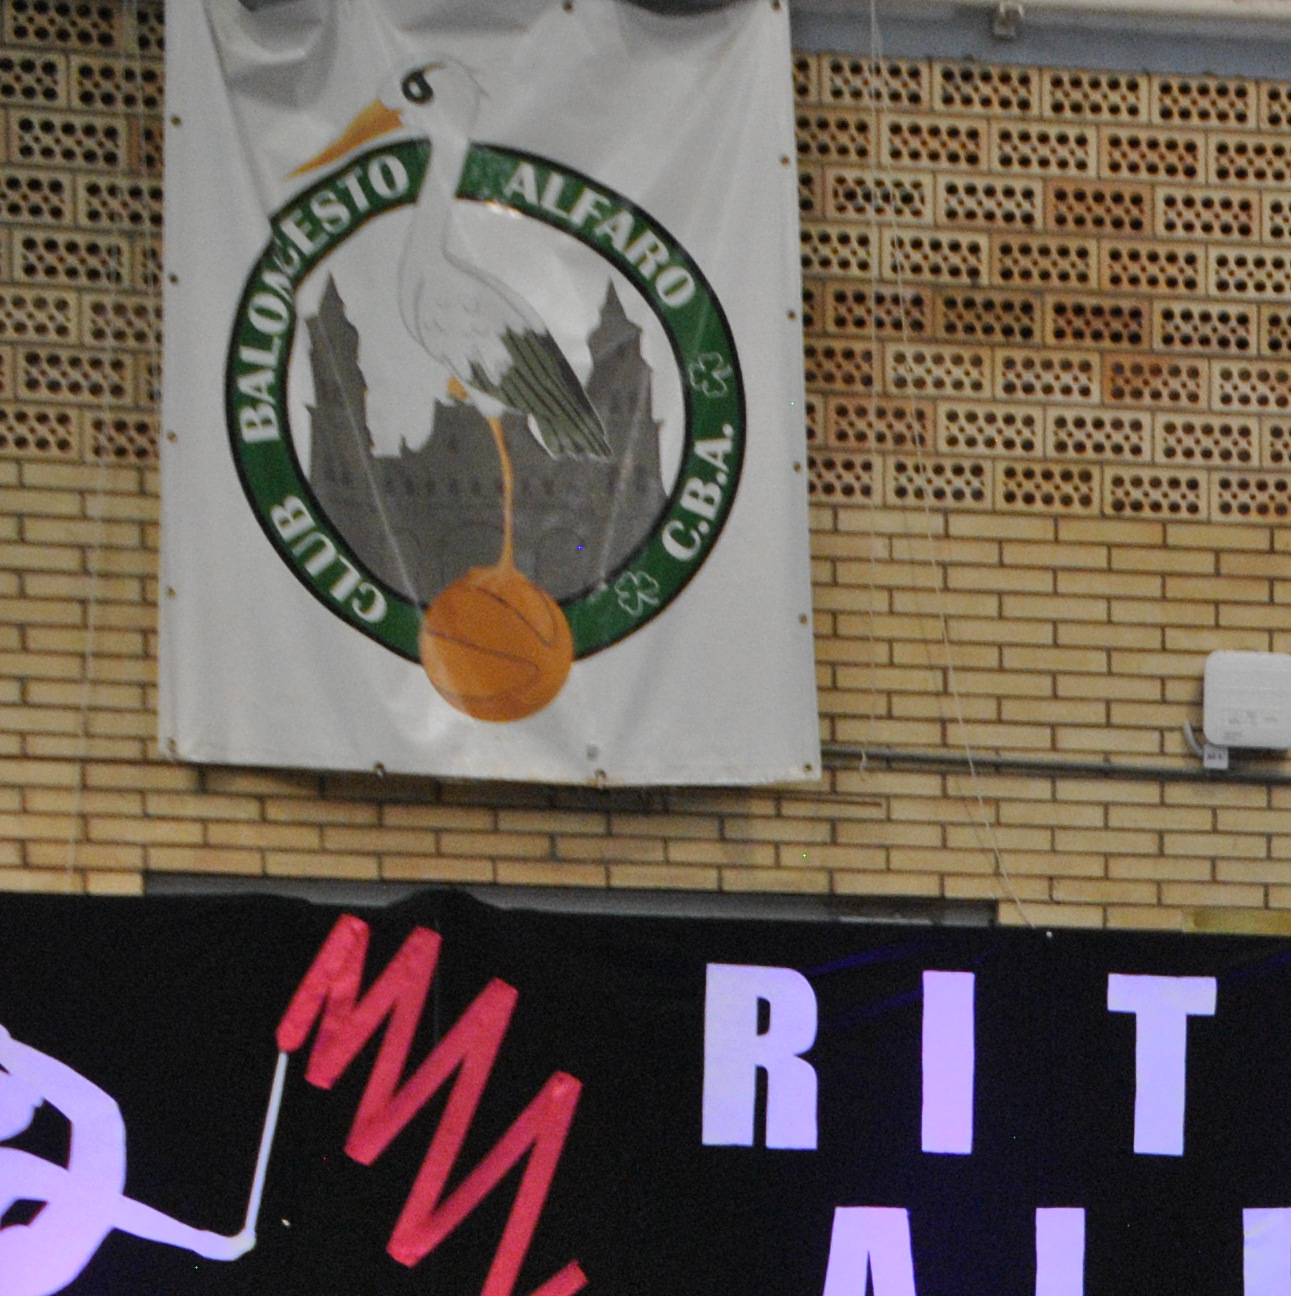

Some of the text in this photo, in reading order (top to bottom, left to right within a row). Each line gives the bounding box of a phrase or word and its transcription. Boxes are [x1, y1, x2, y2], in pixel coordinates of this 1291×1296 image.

[502, 161, 697, 308] ALFARO
[271, 494, 389, 624] CLUB
[661, 423, 735, 562] C.B.A.
